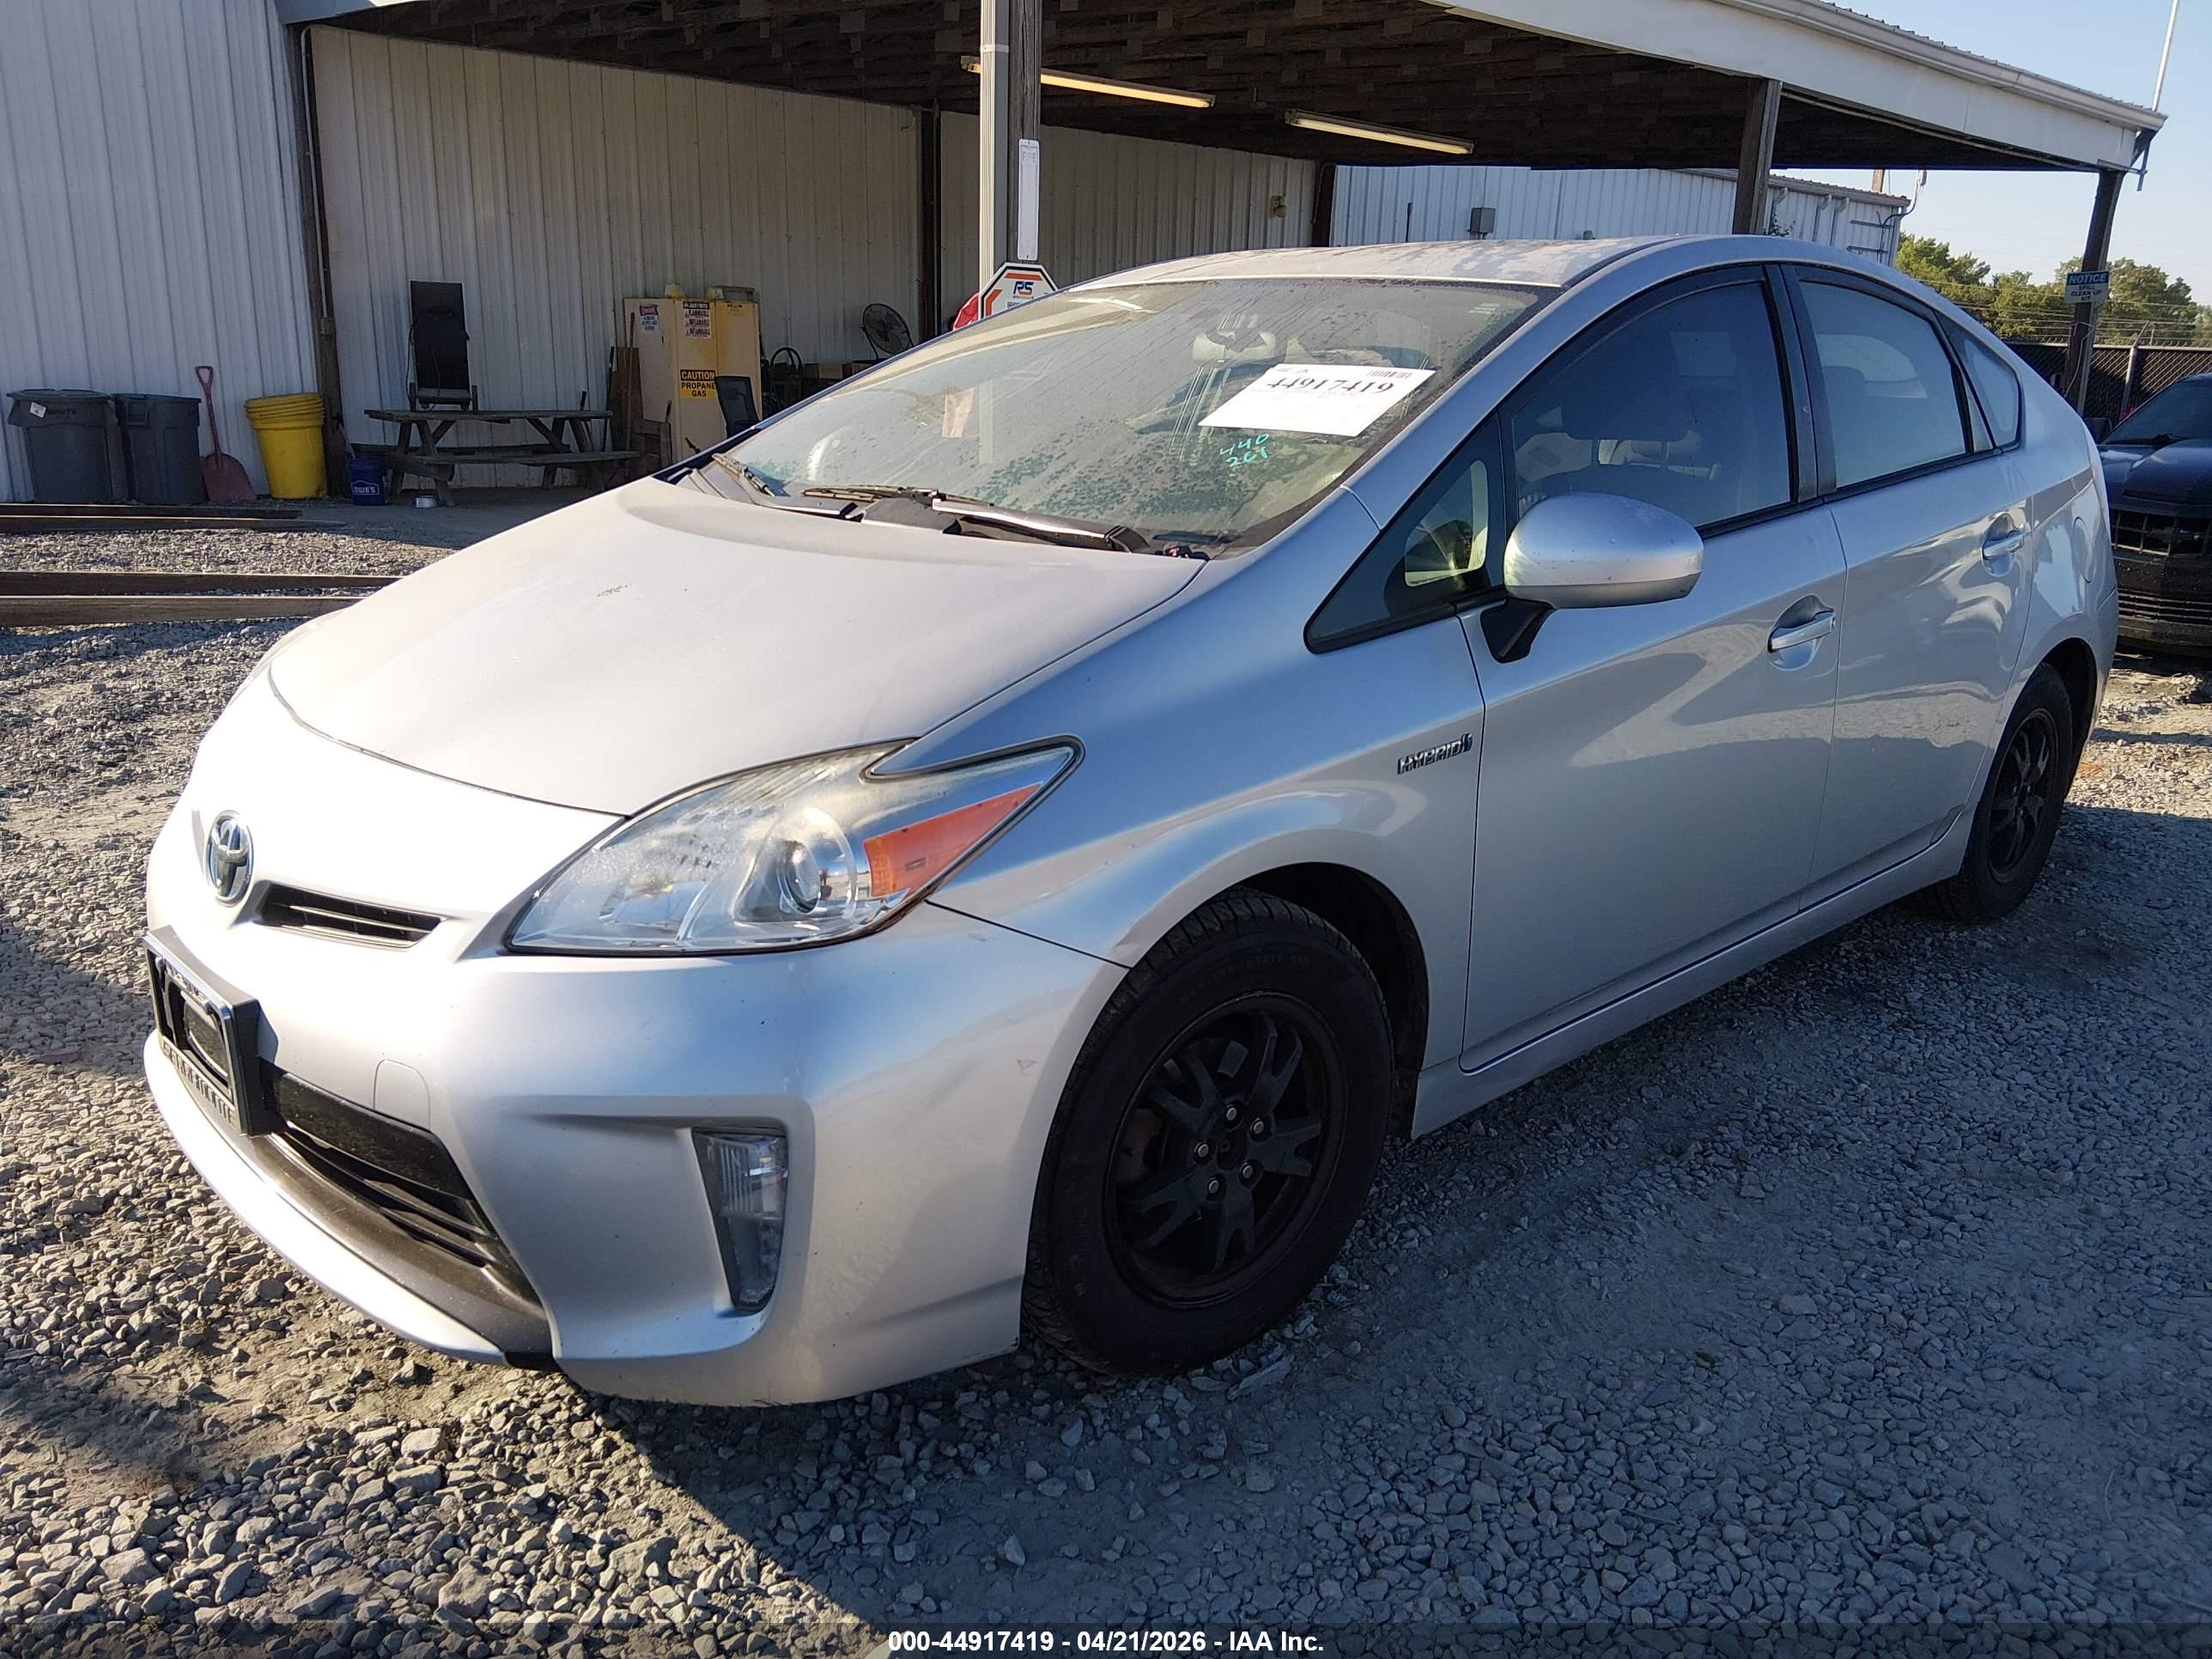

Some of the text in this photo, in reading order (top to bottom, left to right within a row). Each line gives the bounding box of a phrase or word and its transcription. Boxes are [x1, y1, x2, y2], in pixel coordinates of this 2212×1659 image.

[2069, 273, 2107, 283] NOTICE
[681, 370, 714, 380] CAUTION
[1267, 376, 1395, 393] 44917419
[1397, 739, 1462, 775] HYBRID
